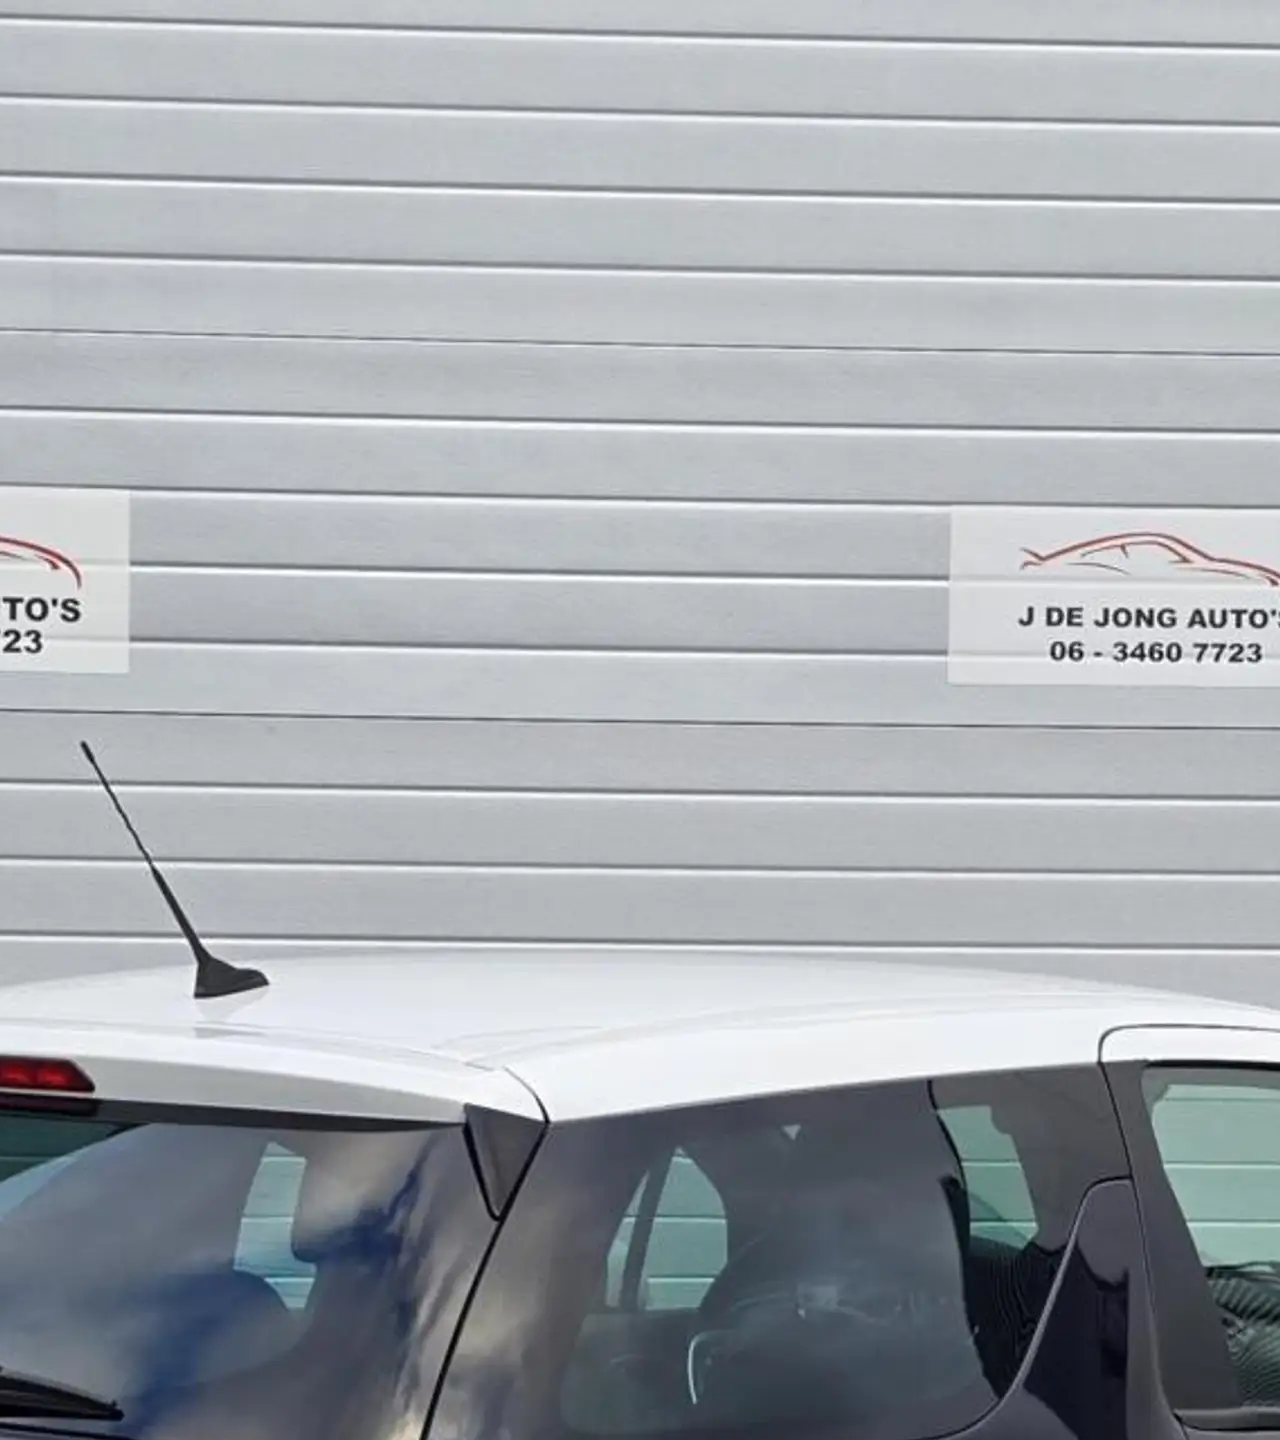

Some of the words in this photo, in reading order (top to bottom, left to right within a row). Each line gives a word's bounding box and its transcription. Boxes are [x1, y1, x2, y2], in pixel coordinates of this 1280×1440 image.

[1018, 606, 1034, 627] J
[1046, 607, 1083, 627] DE
[1094, 607, 1177, 628] JONG
[1050, 641, 1084, 662] 06
[1113, 642, 1182, 663] 3460
[1193, 643, 1262, 663] 7723
